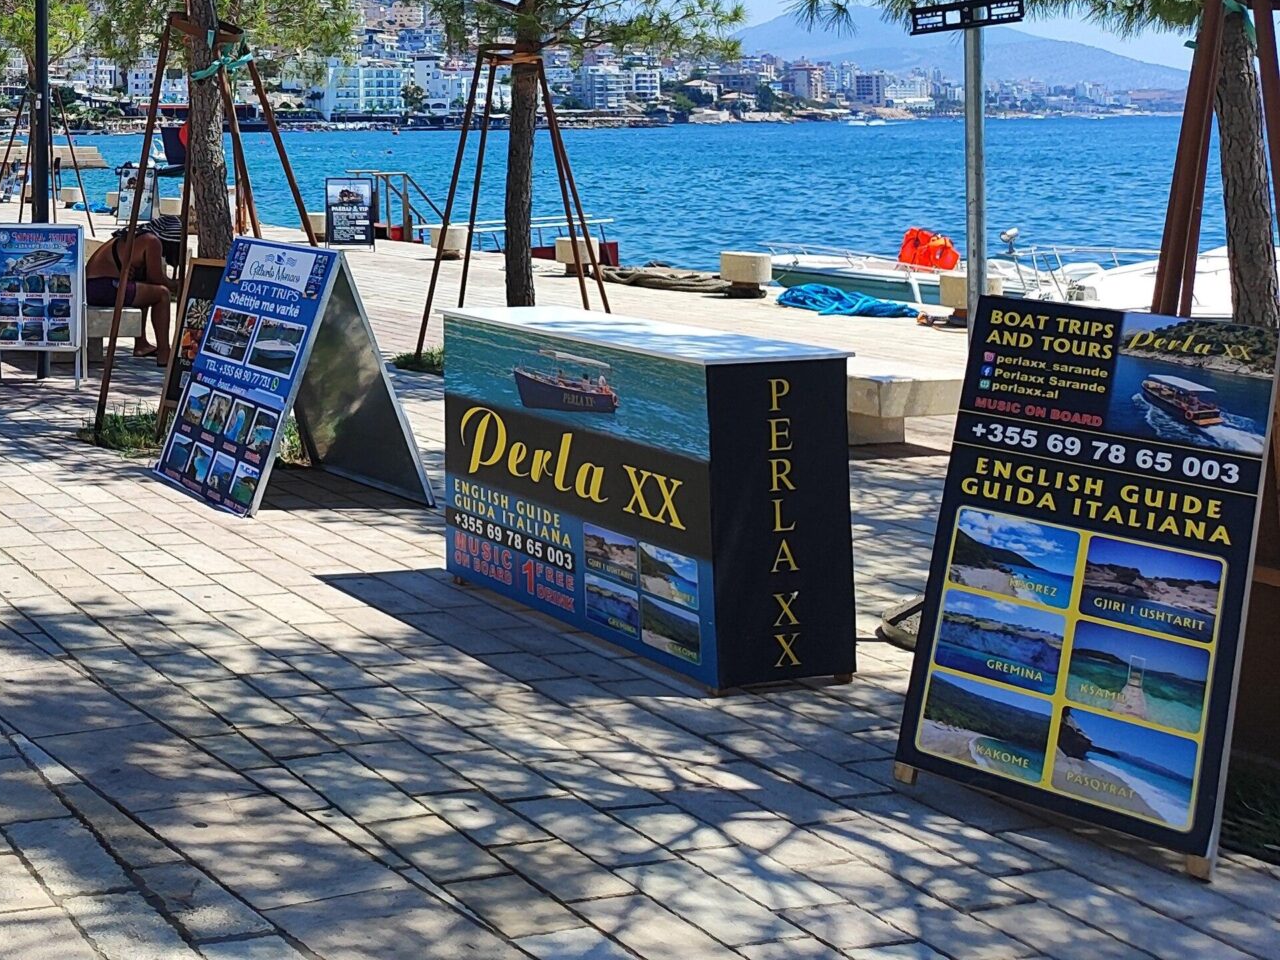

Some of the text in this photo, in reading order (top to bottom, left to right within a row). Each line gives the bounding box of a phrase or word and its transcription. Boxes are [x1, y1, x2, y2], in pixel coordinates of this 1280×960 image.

[240, 281, 299, 302] BOAT TRIPS
[261, 300, 275, 312] me
[990, 309, 1115, 339] BOAT TRIPS
[986, 330, 1113, 359] AND TOURS
[1126, 330, 1253, 361] Perla XX
[219, 364, 234, 377] +355
[234, 368, 242, 380] 68
[252, 373, 261, 384] 77
[994, 368, 1106, 393] Perlaxx Sarande
[996, 355, 1109, 378] perlaxx_sarande
[992, 382, 1059, 399] perlaxx.al
[975, 397, 1102, 427] MUSIC ON BOARD
[972, 423, 1240, 483] +355 69 78 65 003
[459, 406, 687, 531] Perla XX
[455, 478, 560, 528] ENGLISH GUIDE
[975, 457, 1222, 519] ENGLISH GUIDE
[455, 494, 572, 549] GUIDA ITALIANA
[767, 378, 801, 667] PERLA XX
[961, 477, 1232, 546] GUIDA ITALIANA
[455, 512, 573, 570] +355 69 78 65 003
[455, 530, 512, 570] MUSIC
[455, 550, 513, 585] ON BOARD
[522, 559, 575, 595] 1 FREE
[537, 583, 575, 613] DRINK
[1093, 597, 1206, 631] GJIRI I USHTARIT
[986, 658, 1043, 683] GREMINA
[975, 744, 1030, 769] KAKOME
[1066, 771, 1136, 799] PASQYRAT
